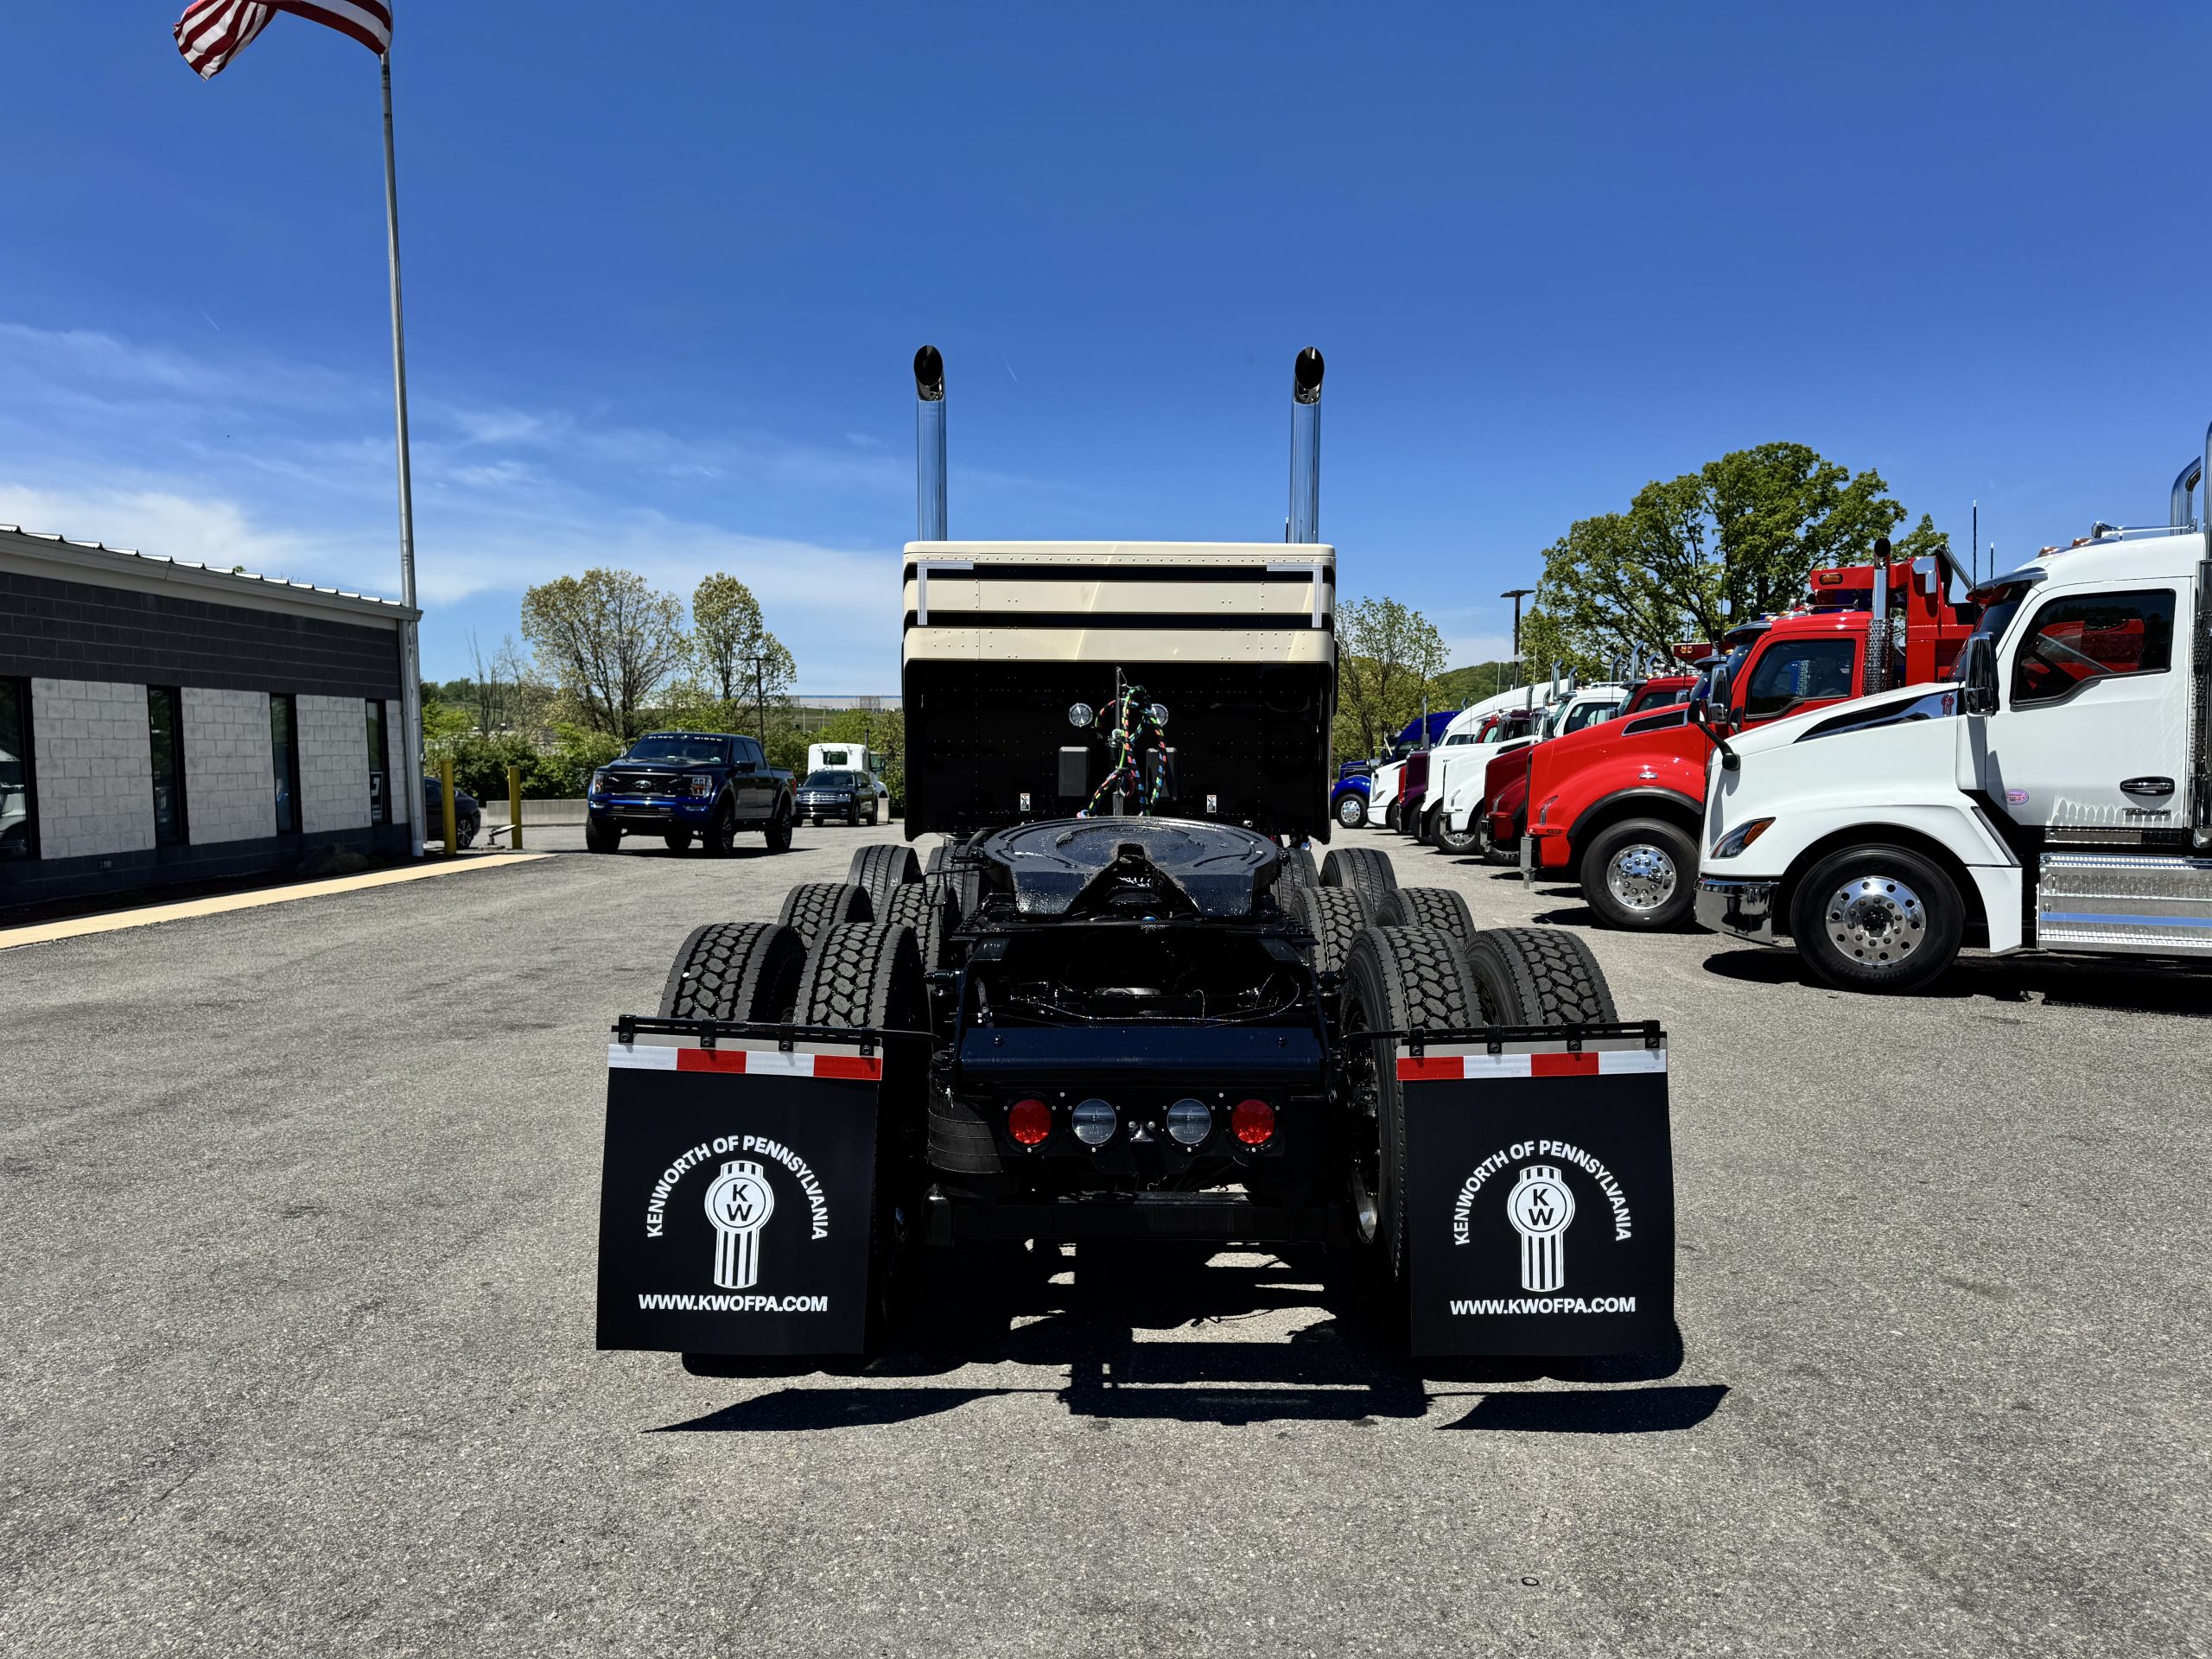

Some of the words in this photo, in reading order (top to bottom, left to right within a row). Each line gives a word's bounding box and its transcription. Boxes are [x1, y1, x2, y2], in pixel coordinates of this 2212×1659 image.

[646, 1142, 712, 1238] KENWORTH
[712, 1135, 739, 1154] OF
[742, 1135, 829, 1240] PENNSYLVANIA
[733, 1184, 750, 1202] K
[1453, 1149, 1510, 1246] KENWORTH
[1510, 1140, 1535, 1160] OF
[1539, 1140, 1632, 1242] PENNSYLVANIA
[1533, 1188, 1548, 1206] K
[727, 1204, 753, 1221] W
[1528, 1208, 1554, 1225] W
[638, 1294, 829, 1313] WWW.KWOFPA.COM
[1449, 1297, 1637, 1315] WWW.KWOFPA.COM
